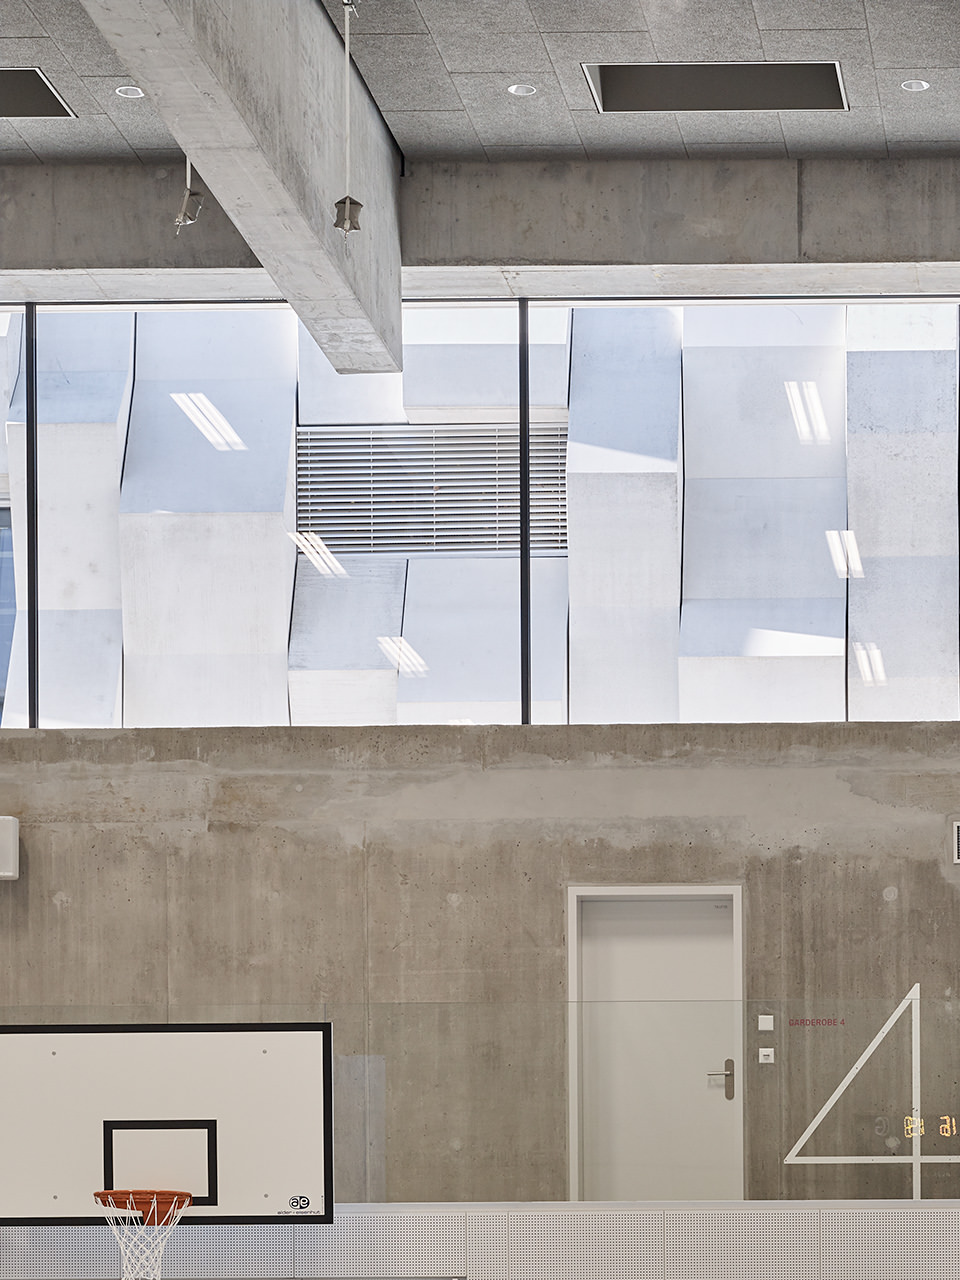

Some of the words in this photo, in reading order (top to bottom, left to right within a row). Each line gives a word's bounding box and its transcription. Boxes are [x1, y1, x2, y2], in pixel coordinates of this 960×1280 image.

[788, 1018, 838, 1027] GARDEROBE
[839, 1018, 846, 1026] 4
[290, 1196, 310, 1209] ae
